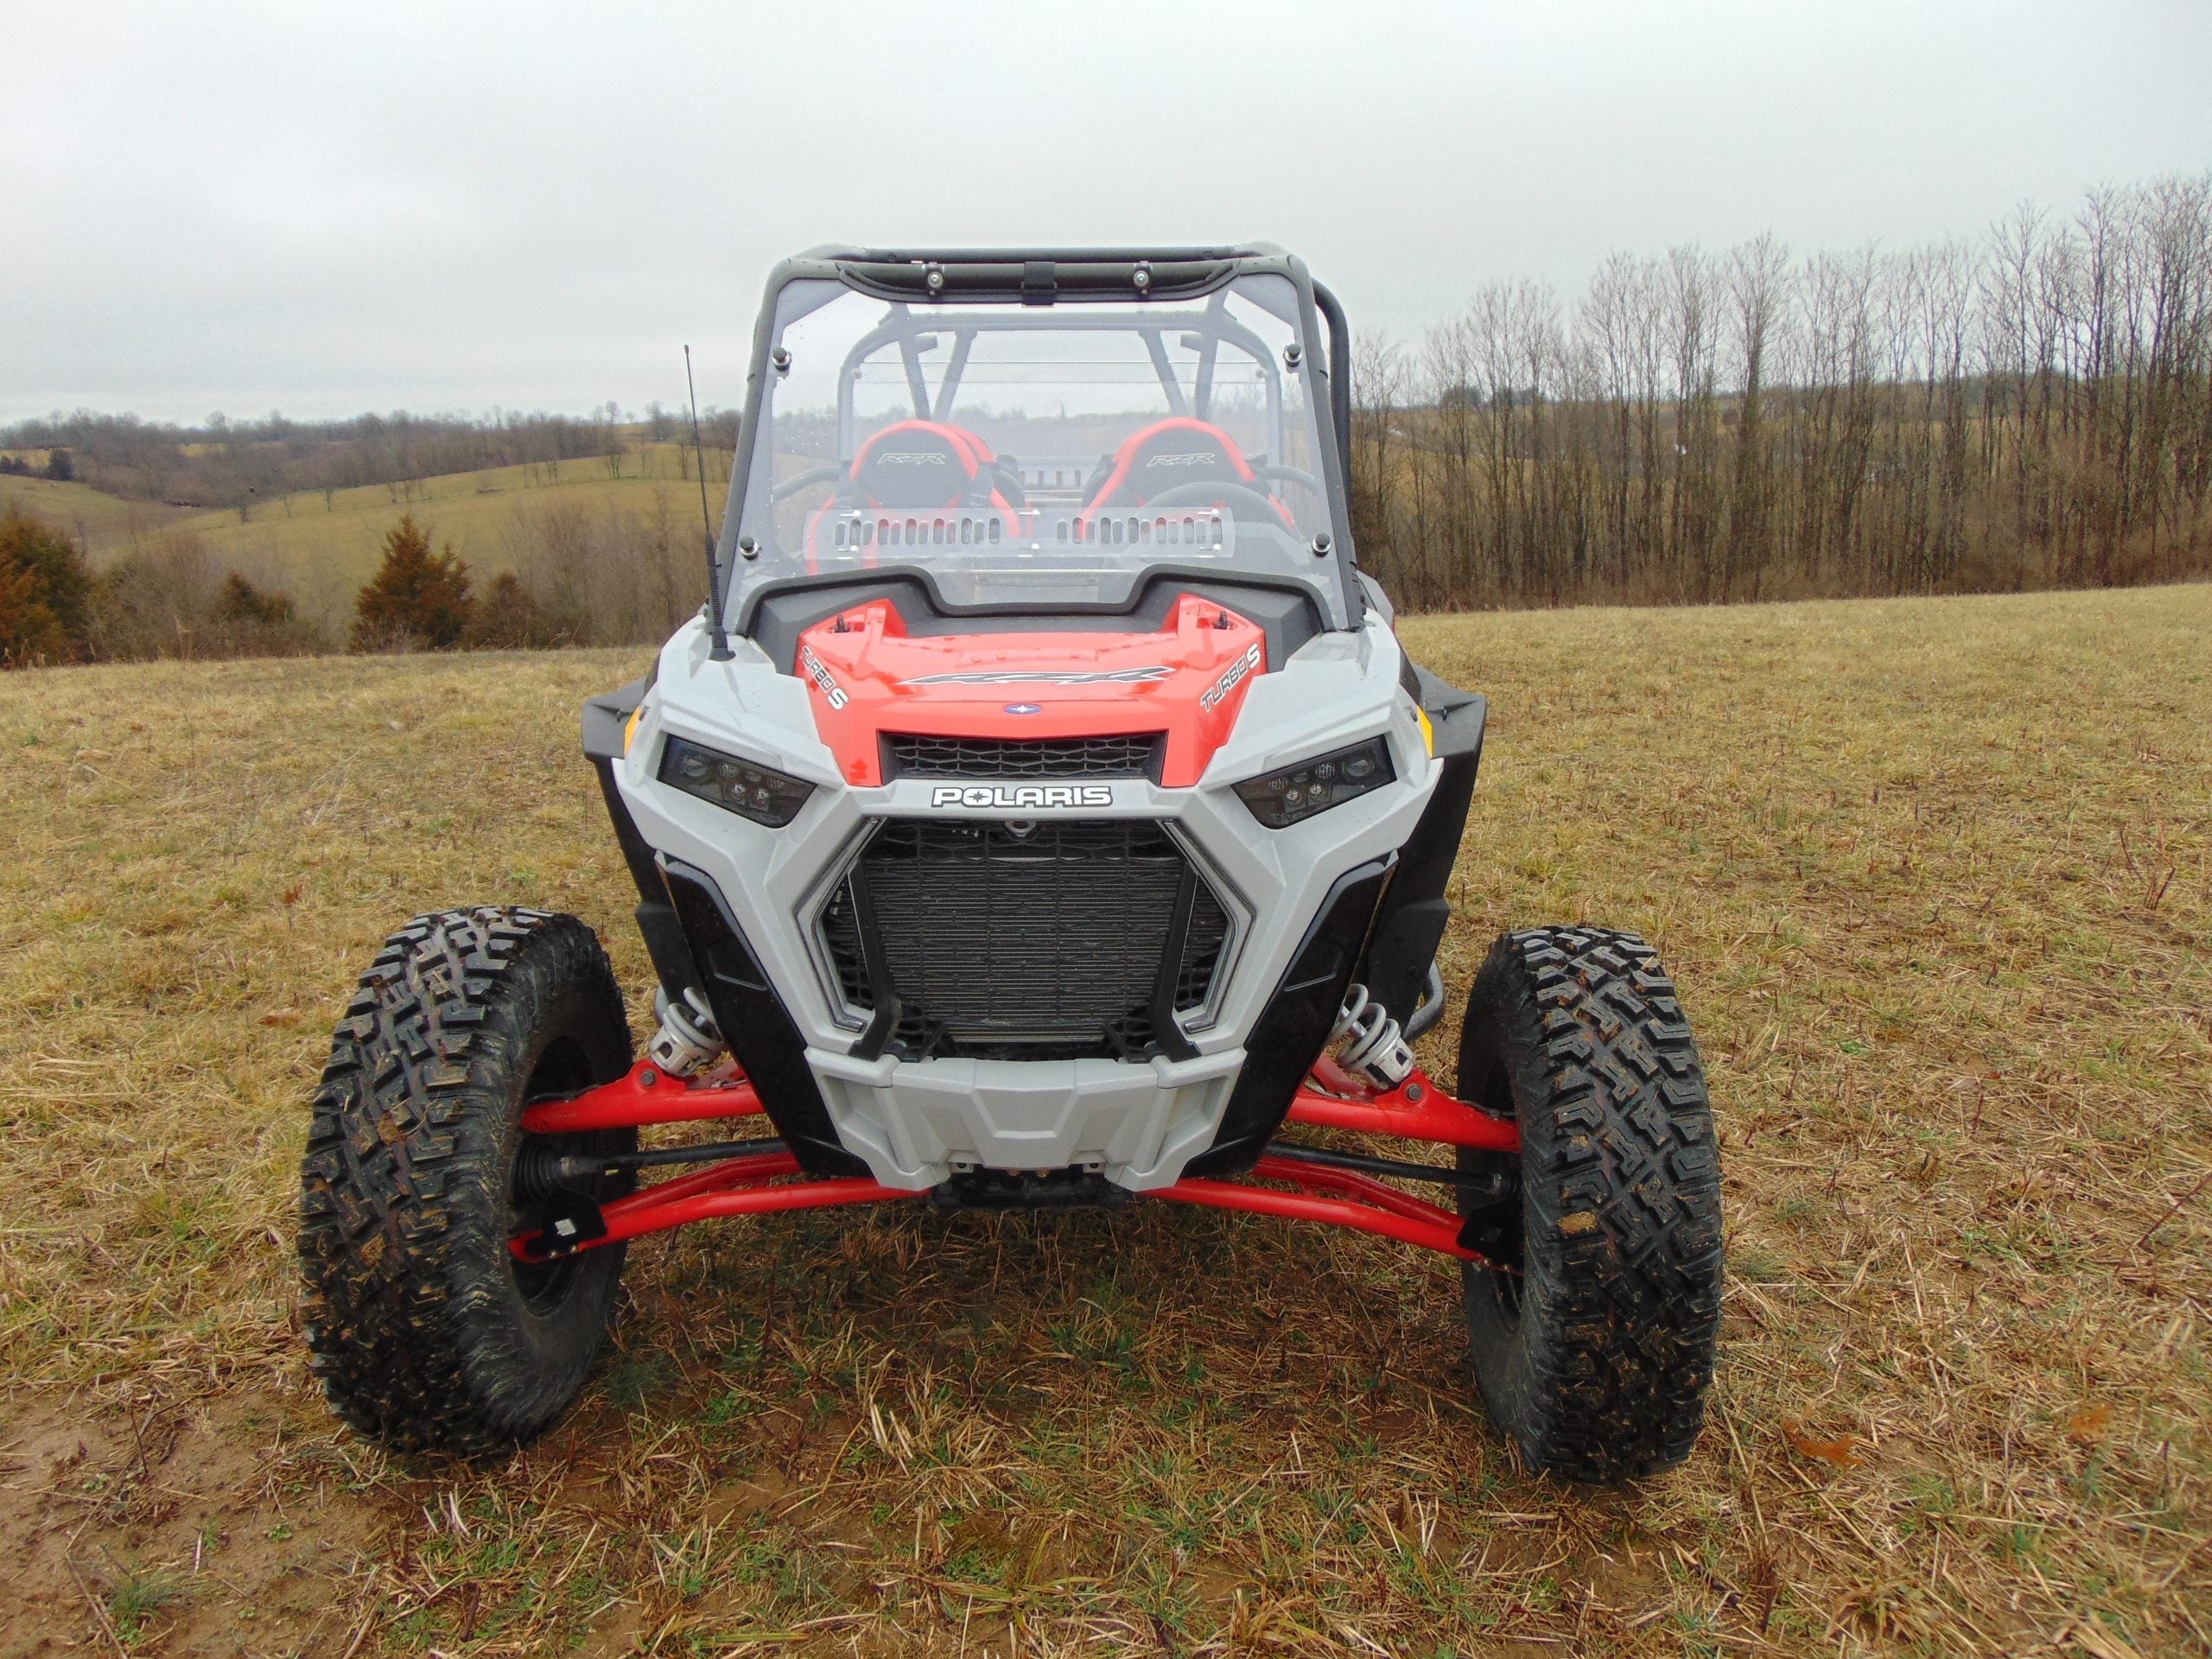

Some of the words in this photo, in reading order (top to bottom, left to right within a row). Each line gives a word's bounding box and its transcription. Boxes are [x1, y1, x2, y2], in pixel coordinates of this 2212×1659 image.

[799, 645, 836, 694] TURBO
[827, 687, 849, 709] S
[1200, 654, 1249, 713] TURBO
[1246, 642, 1261, 669] S
[931, 786, 1114, 808] POLARIS
